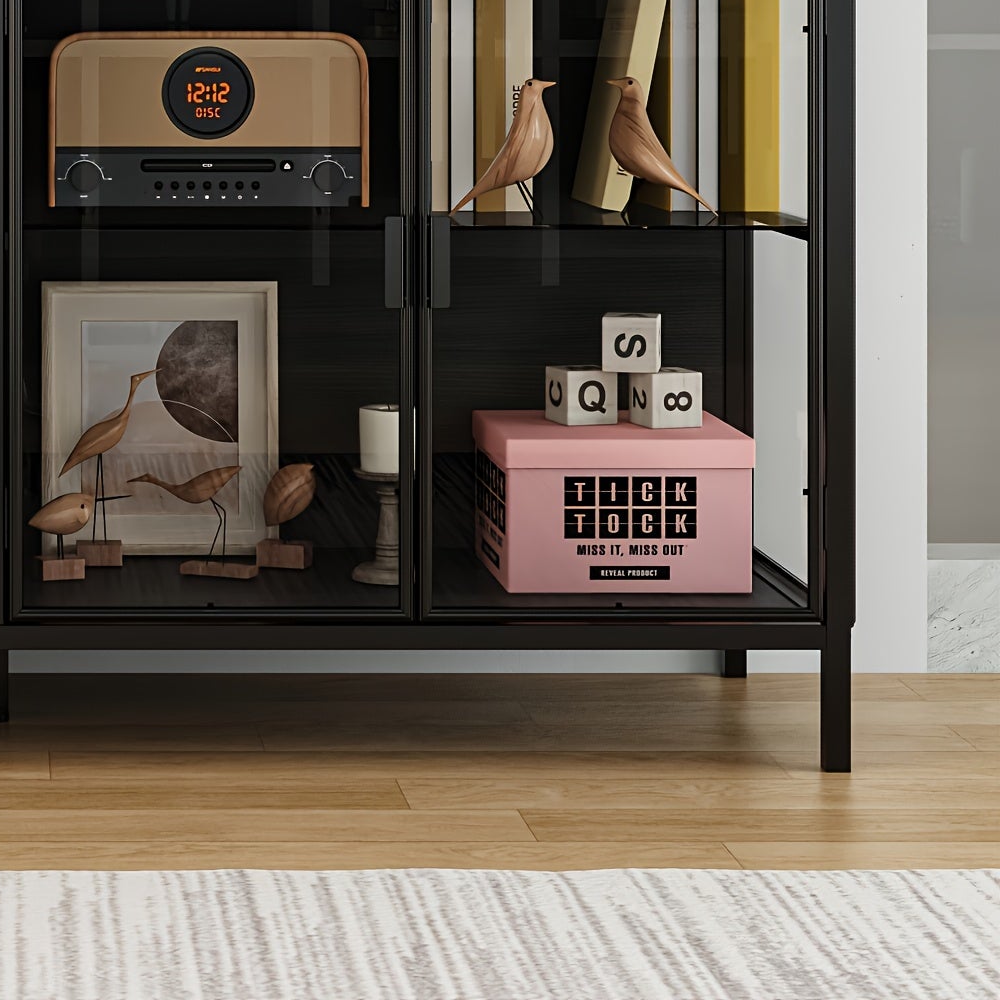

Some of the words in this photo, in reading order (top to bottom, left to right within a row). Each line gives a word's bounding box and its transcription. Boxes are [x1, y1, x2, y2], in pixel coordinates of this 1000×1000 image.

[187, 82, 230, 103] 12:12
[614, 333, 647, 358] S
[578, 380, 607, 414] Q
[663, 391, 693, 412] 8
[573, 482, 688, 502] TICK
[573, 513, 688, 534] TOCK
[576, 544, 606, 556] MISS
[610, 544, 624, 557] IT,
[629, 544, 658, 556] MISS
[662, 544, 685, 556] OUT
[600, 569, 626, 577] REVEAL
[627, 569, 658, 577] PRODUCT
